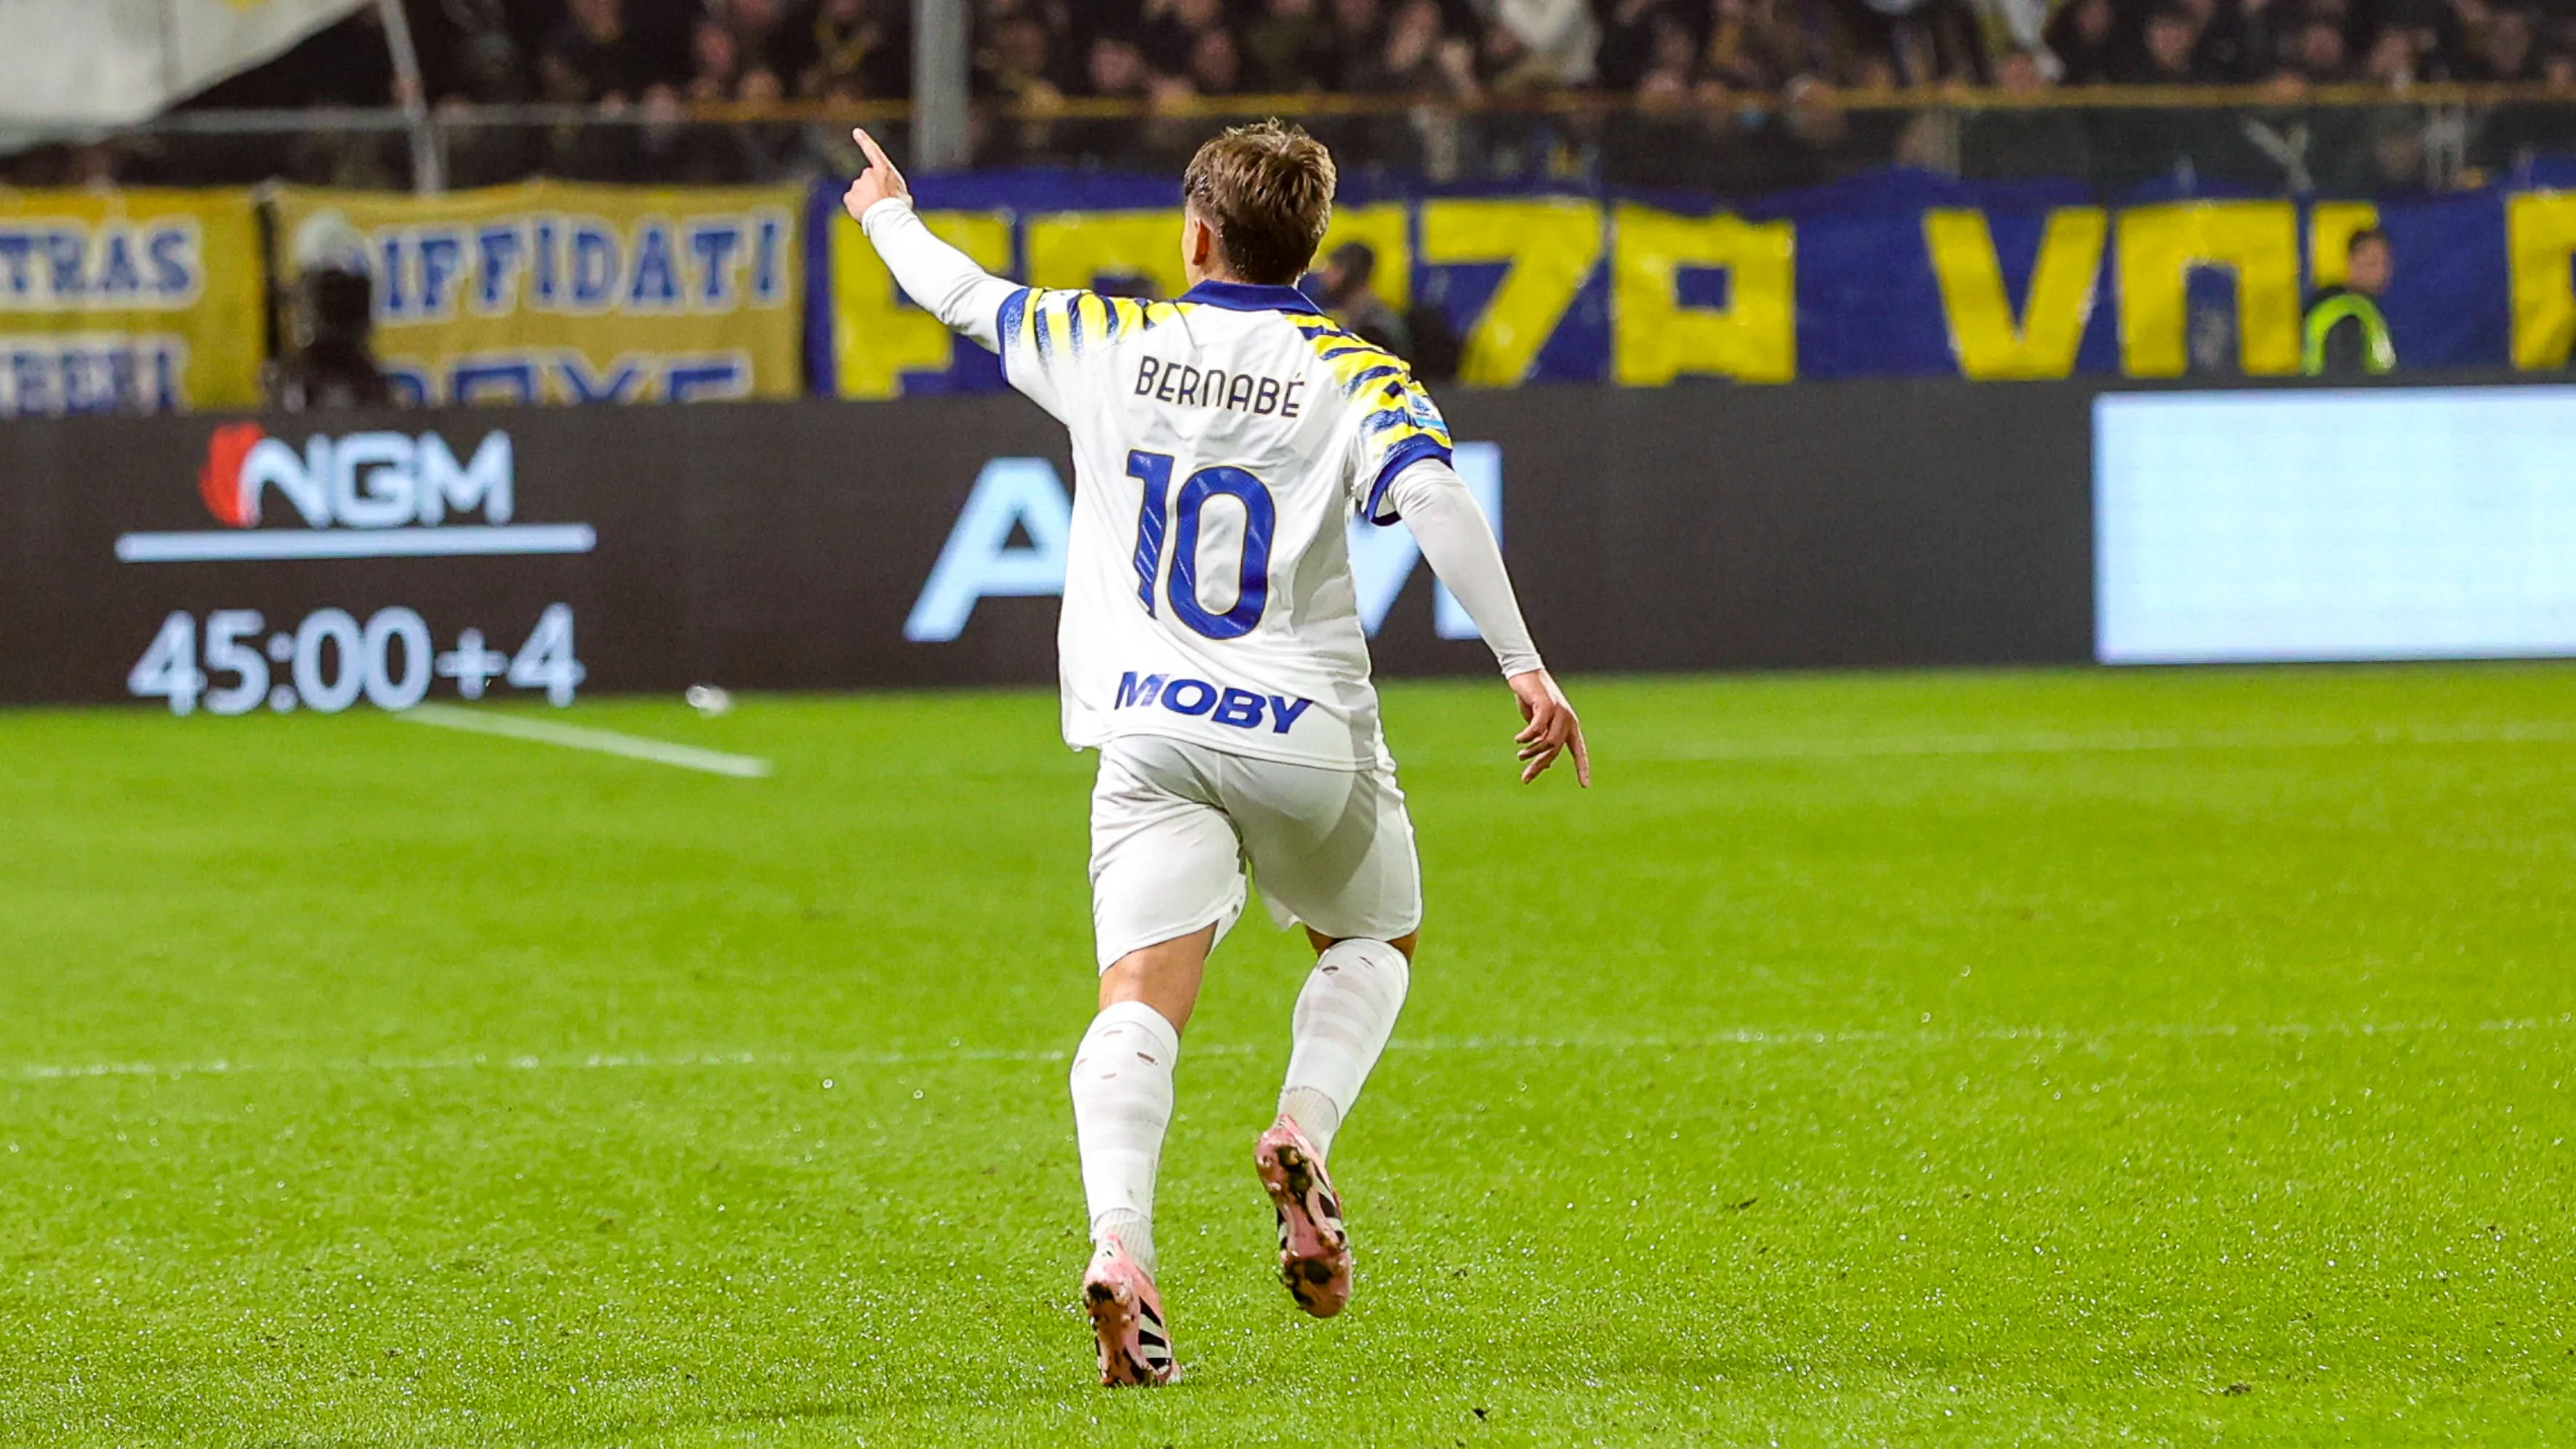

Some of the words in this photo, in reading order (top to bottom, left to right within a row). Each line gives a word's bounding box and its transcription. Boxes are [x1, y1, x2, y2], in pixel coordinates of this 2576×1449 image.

[353, 220, 778, 313] IFFIDATI
[1134, 355, 1306, 418] BERNABÉ
[236, 428, 514, 531] NGM
[1125, 449, 1277, 641] 10
[127, 601, 587, 718] 45:00+4
[1114, 670, 1314, 734] MOBY
